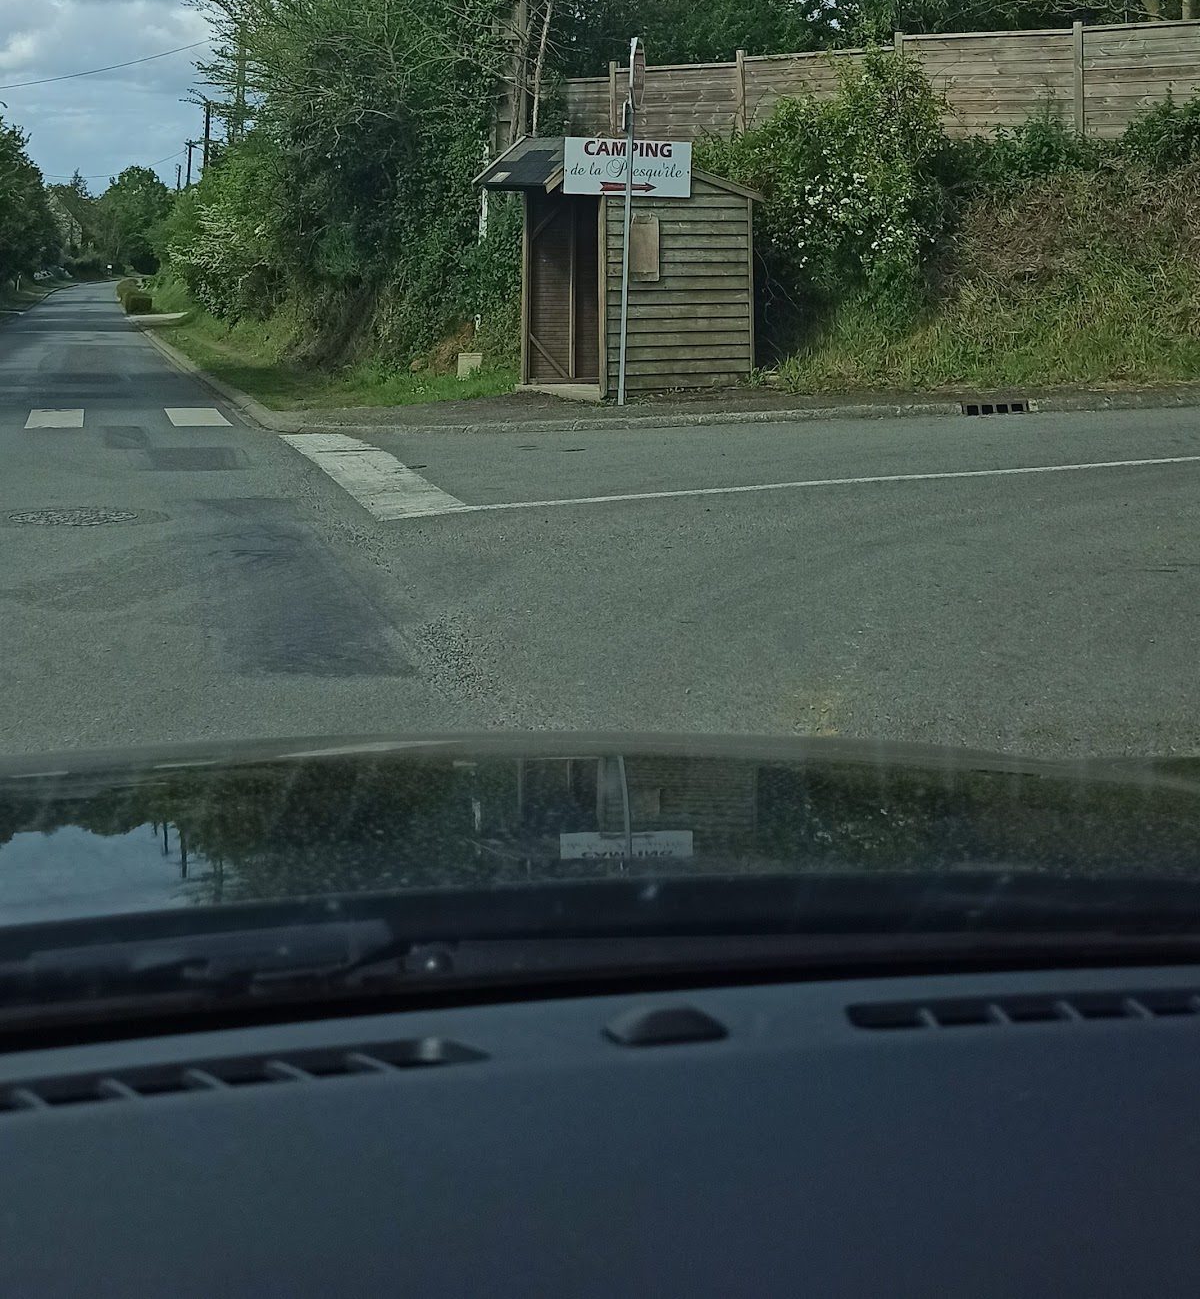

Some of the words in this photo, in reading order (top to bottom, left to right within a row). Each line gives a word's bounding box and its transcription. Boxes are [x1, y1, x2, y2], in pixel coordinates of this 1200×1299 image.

[570, 163, 587, 176] de
[589, 162, 602, 176] la
[605, 157, 683, 182] Pesqu'île
